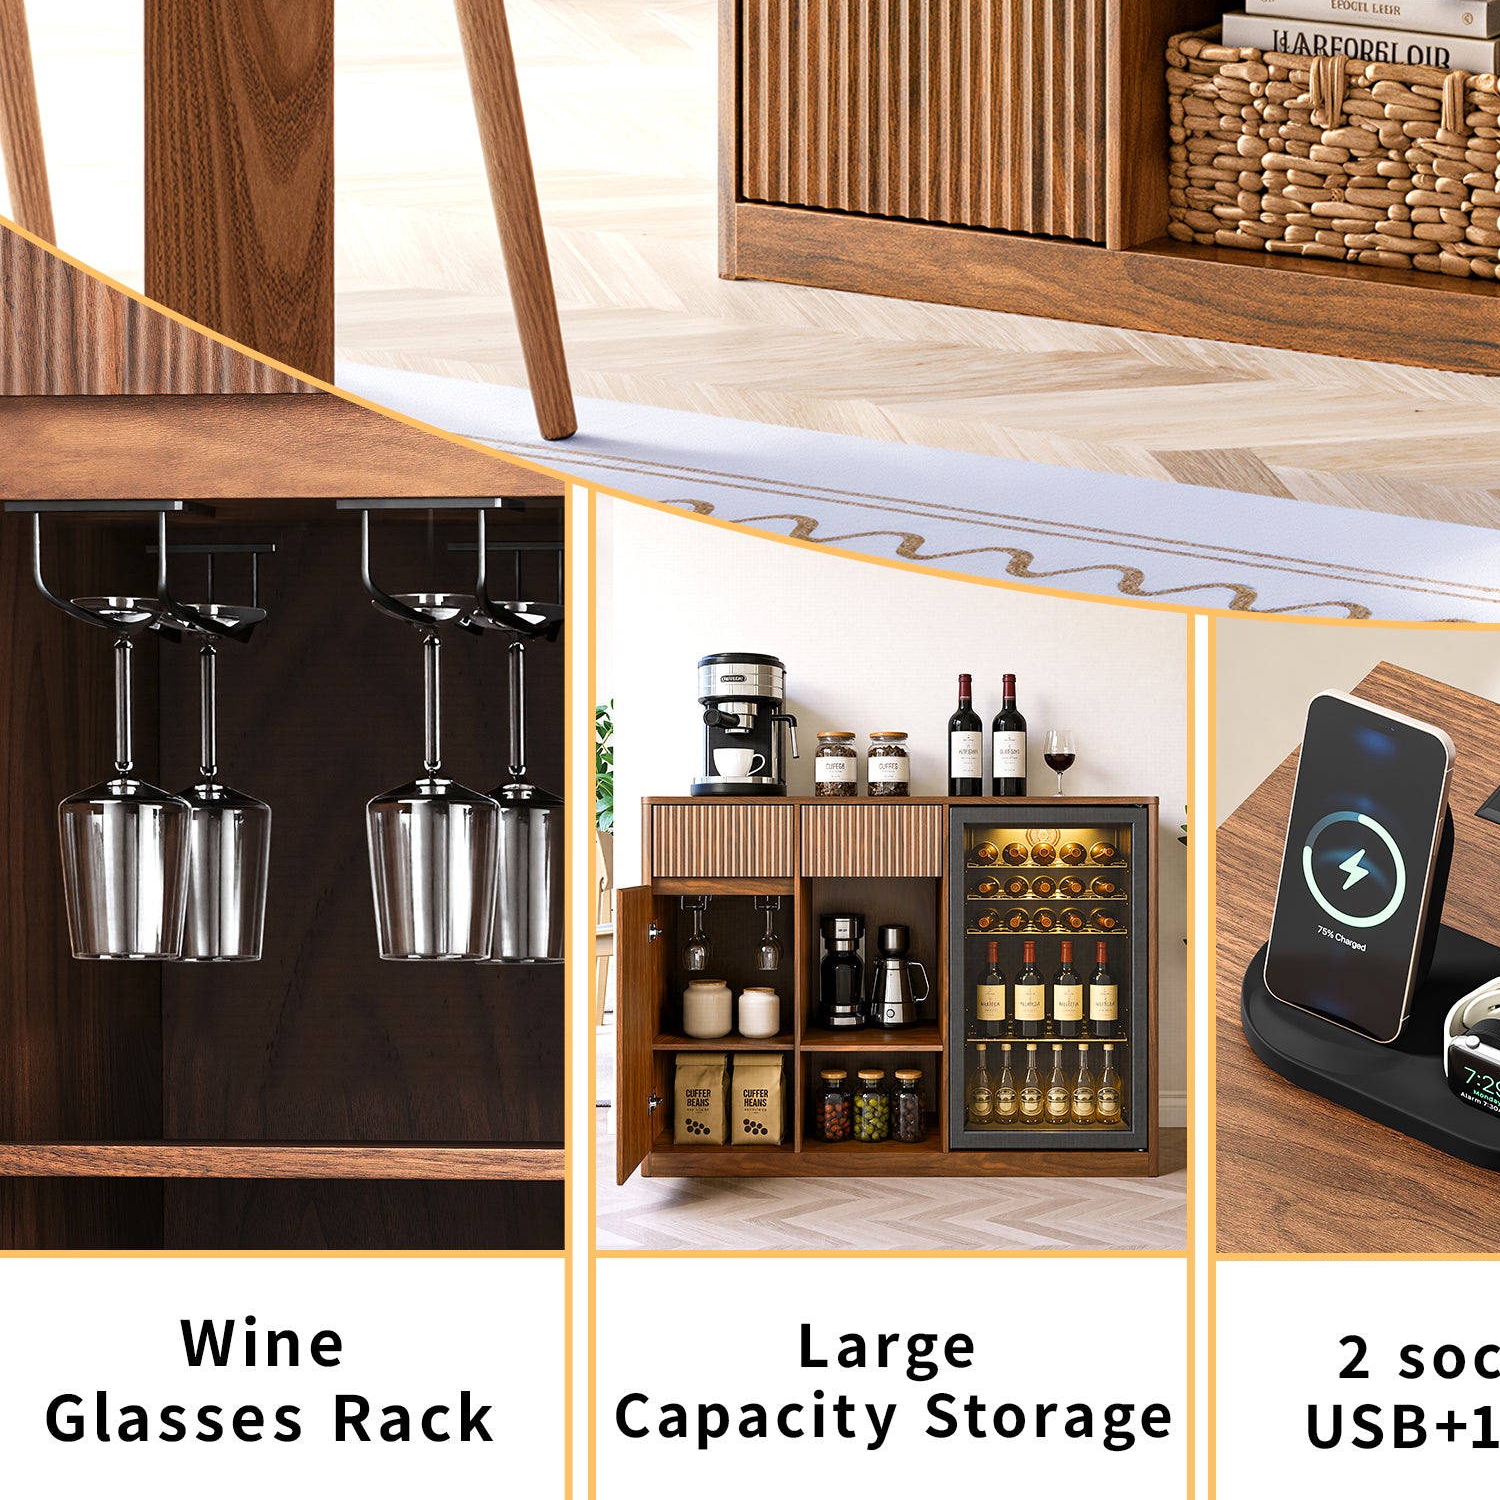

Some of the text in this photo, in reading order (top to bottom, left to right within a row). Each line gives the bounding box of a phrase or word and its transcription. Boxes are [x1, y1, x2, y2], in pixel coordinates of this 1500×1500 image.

[1317, 924, 1367, 952] 75% Charged
[686, 1098, 710, 1107] BEANS
[1460, 1091, 1482, 1105] Alarm
